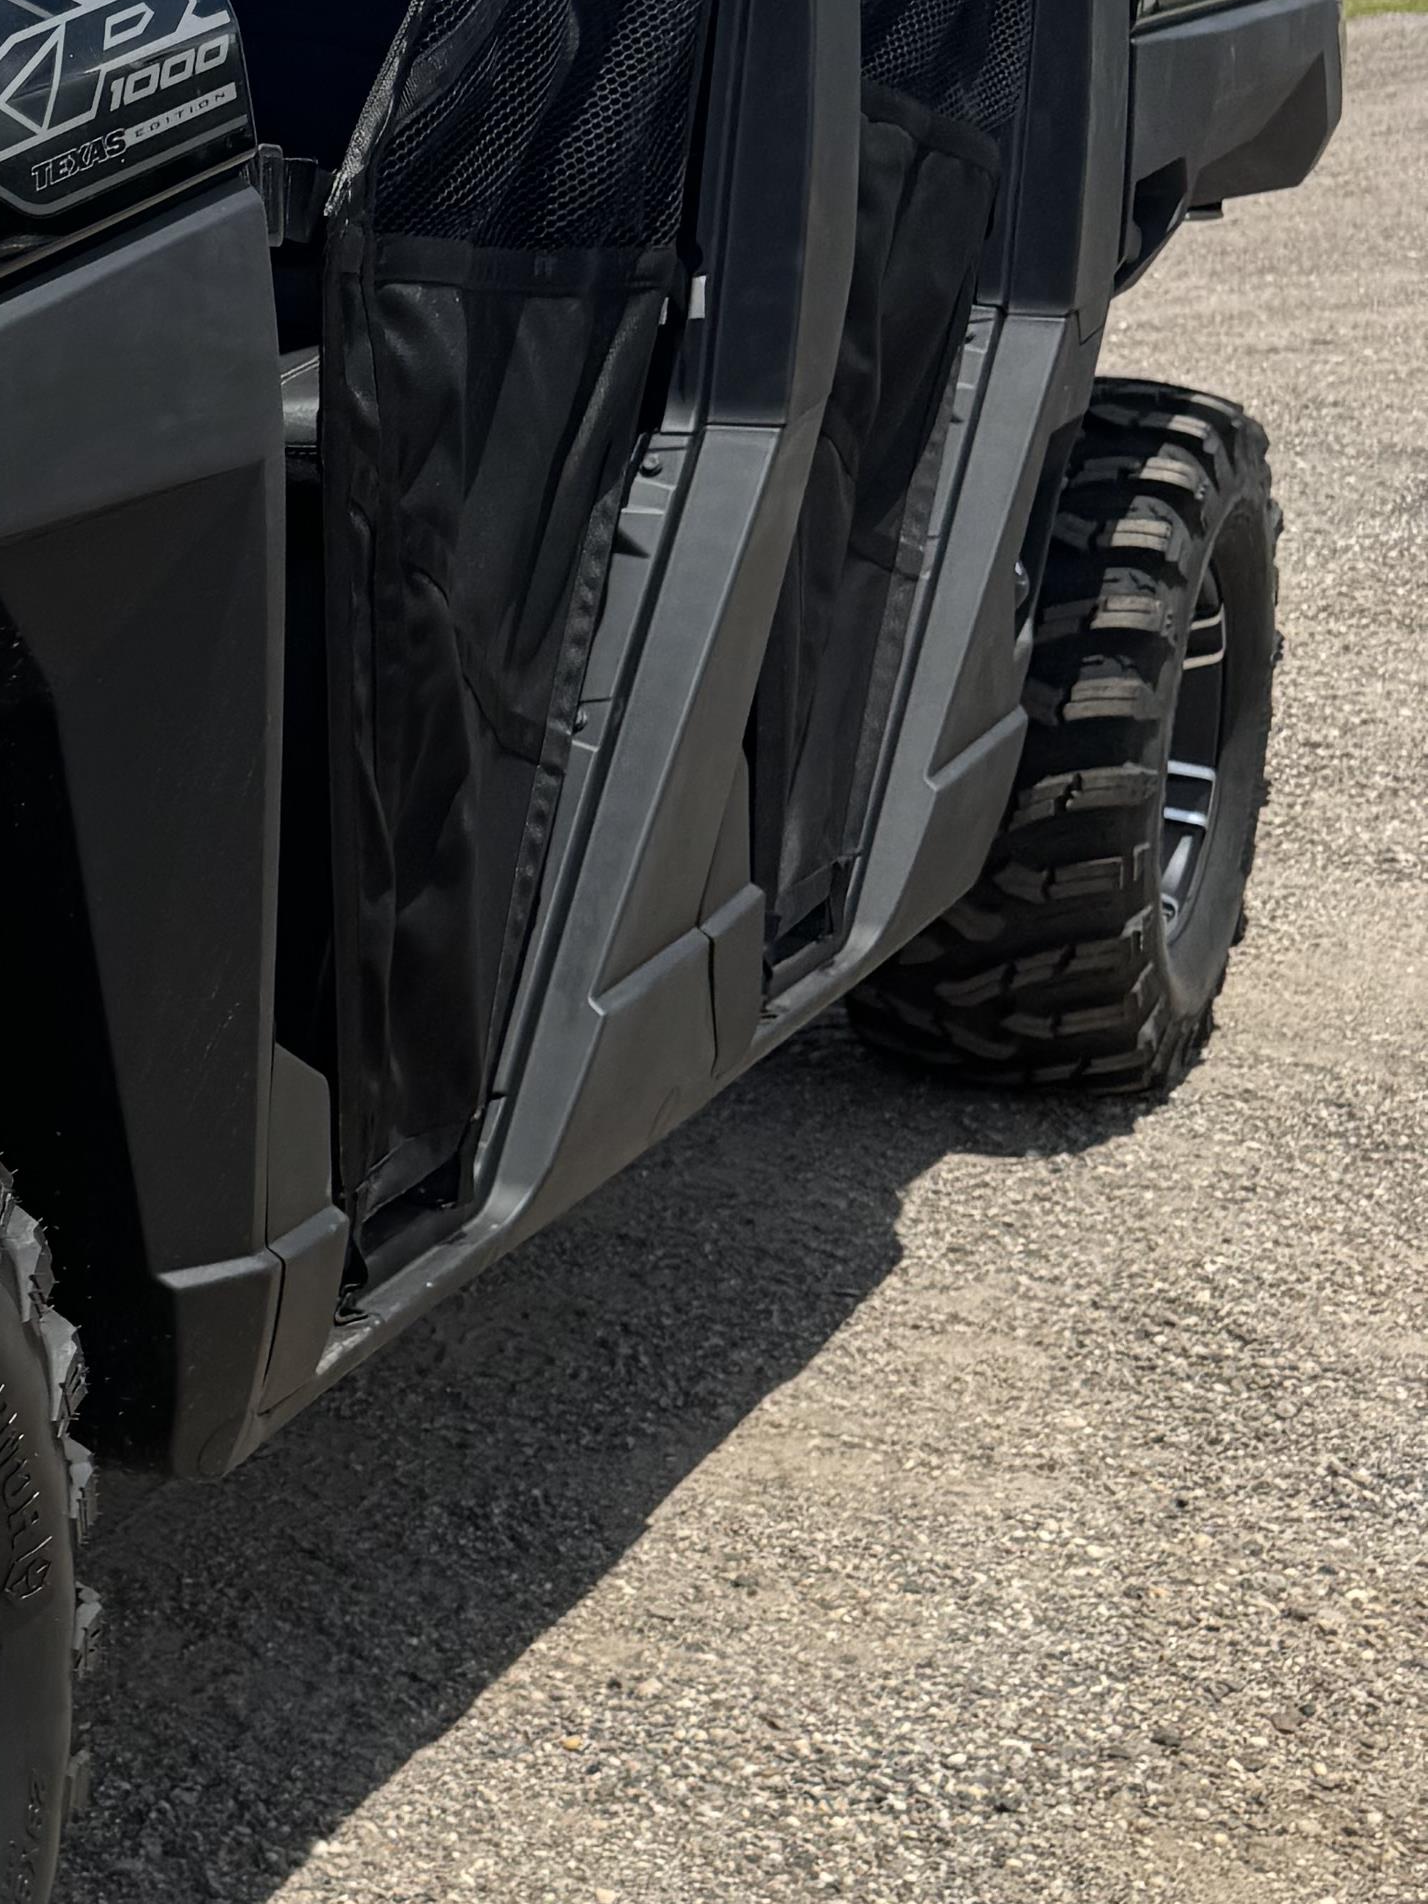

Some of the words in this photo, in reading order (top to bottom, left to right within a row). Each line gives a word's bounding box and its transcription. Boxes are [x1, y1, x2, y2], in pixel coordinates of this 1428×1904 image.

[109, 33, 231, 112] 1000
[30, 127, 129, 192] TEXAS
[133, 92, 226, 139] EDITION
